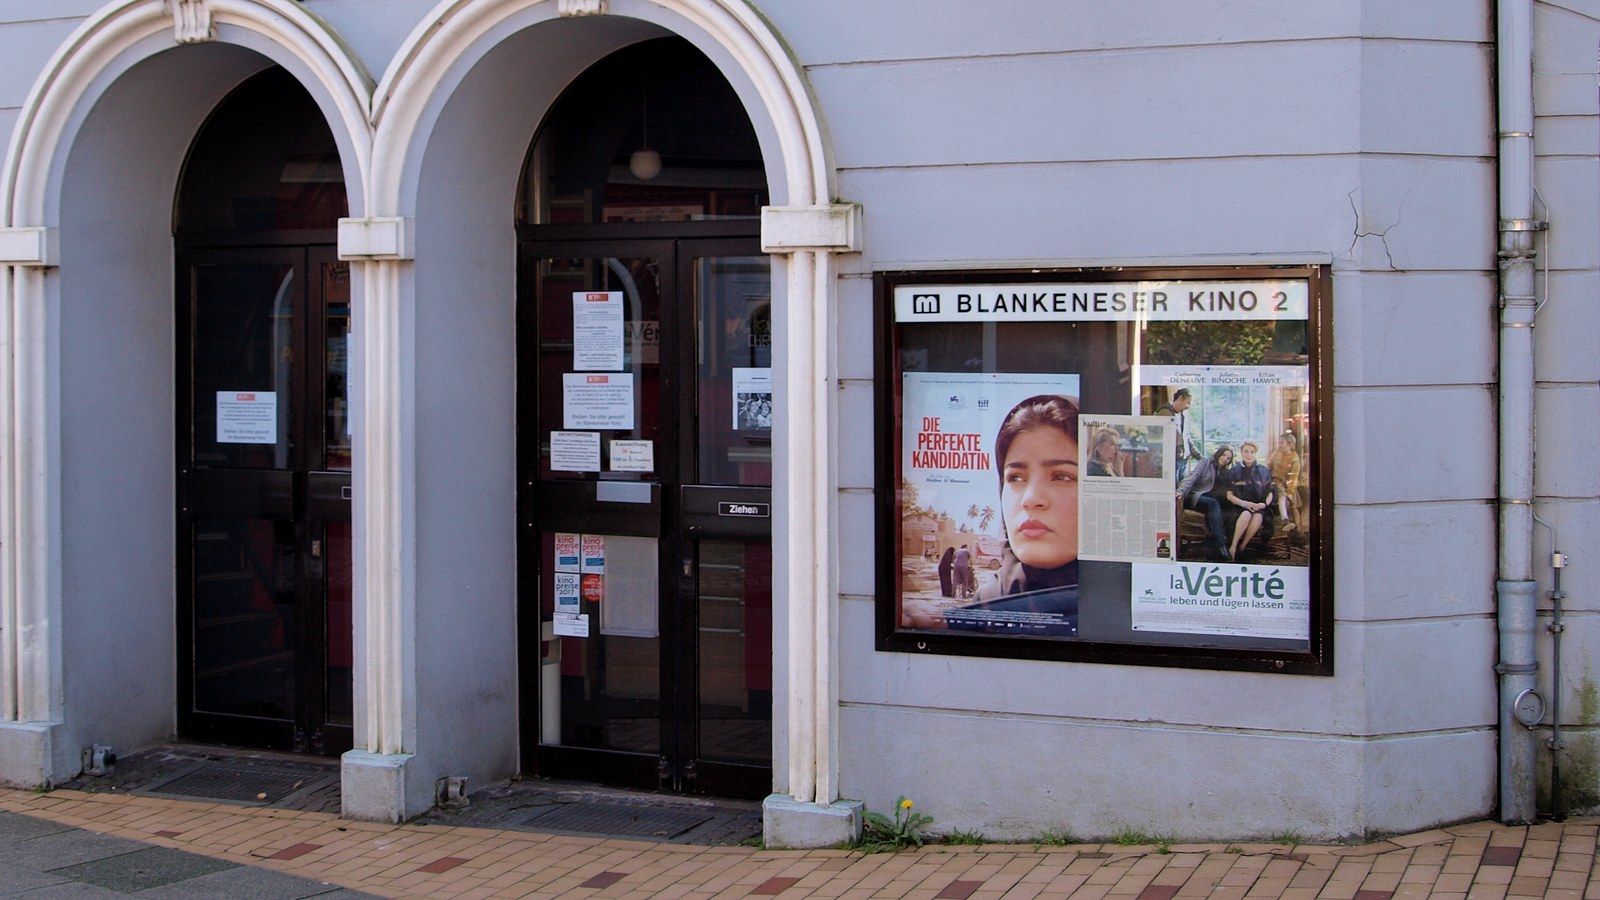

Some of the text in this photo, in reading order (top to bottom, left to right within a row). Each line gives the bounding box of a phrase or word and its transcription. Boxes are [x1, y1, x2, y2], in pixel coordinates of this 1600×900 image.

[957, 291, 1168, 313] BLANKENESER
[1188, 290, 1257, 312] KINO
[1272, 291, 1288, 311] 2
[923, 417, 941, 433] DIE
[918, 433, 982, 452] PERFEKTE
[912, 451, 990, 471] KANDIDATIN
[729, 504, 758, 514] Ziehen
[557, 536, 574, 544] kino
[584, 537, 601, 545] kino
[556, 543, 579, 551] preise
[583, 544, 605, 552] preise
[557, 576, 574, 584] kino
[1170, 566, 1285, 600] la Vérité
[556, 583, 579, 591] preise
[1170, 596, 1198, 606] leben
[1200, 598, 1219, 607] und
[1221, 599, 1250, 609] lügen
[1251, 600, 1284, 609] lassen
